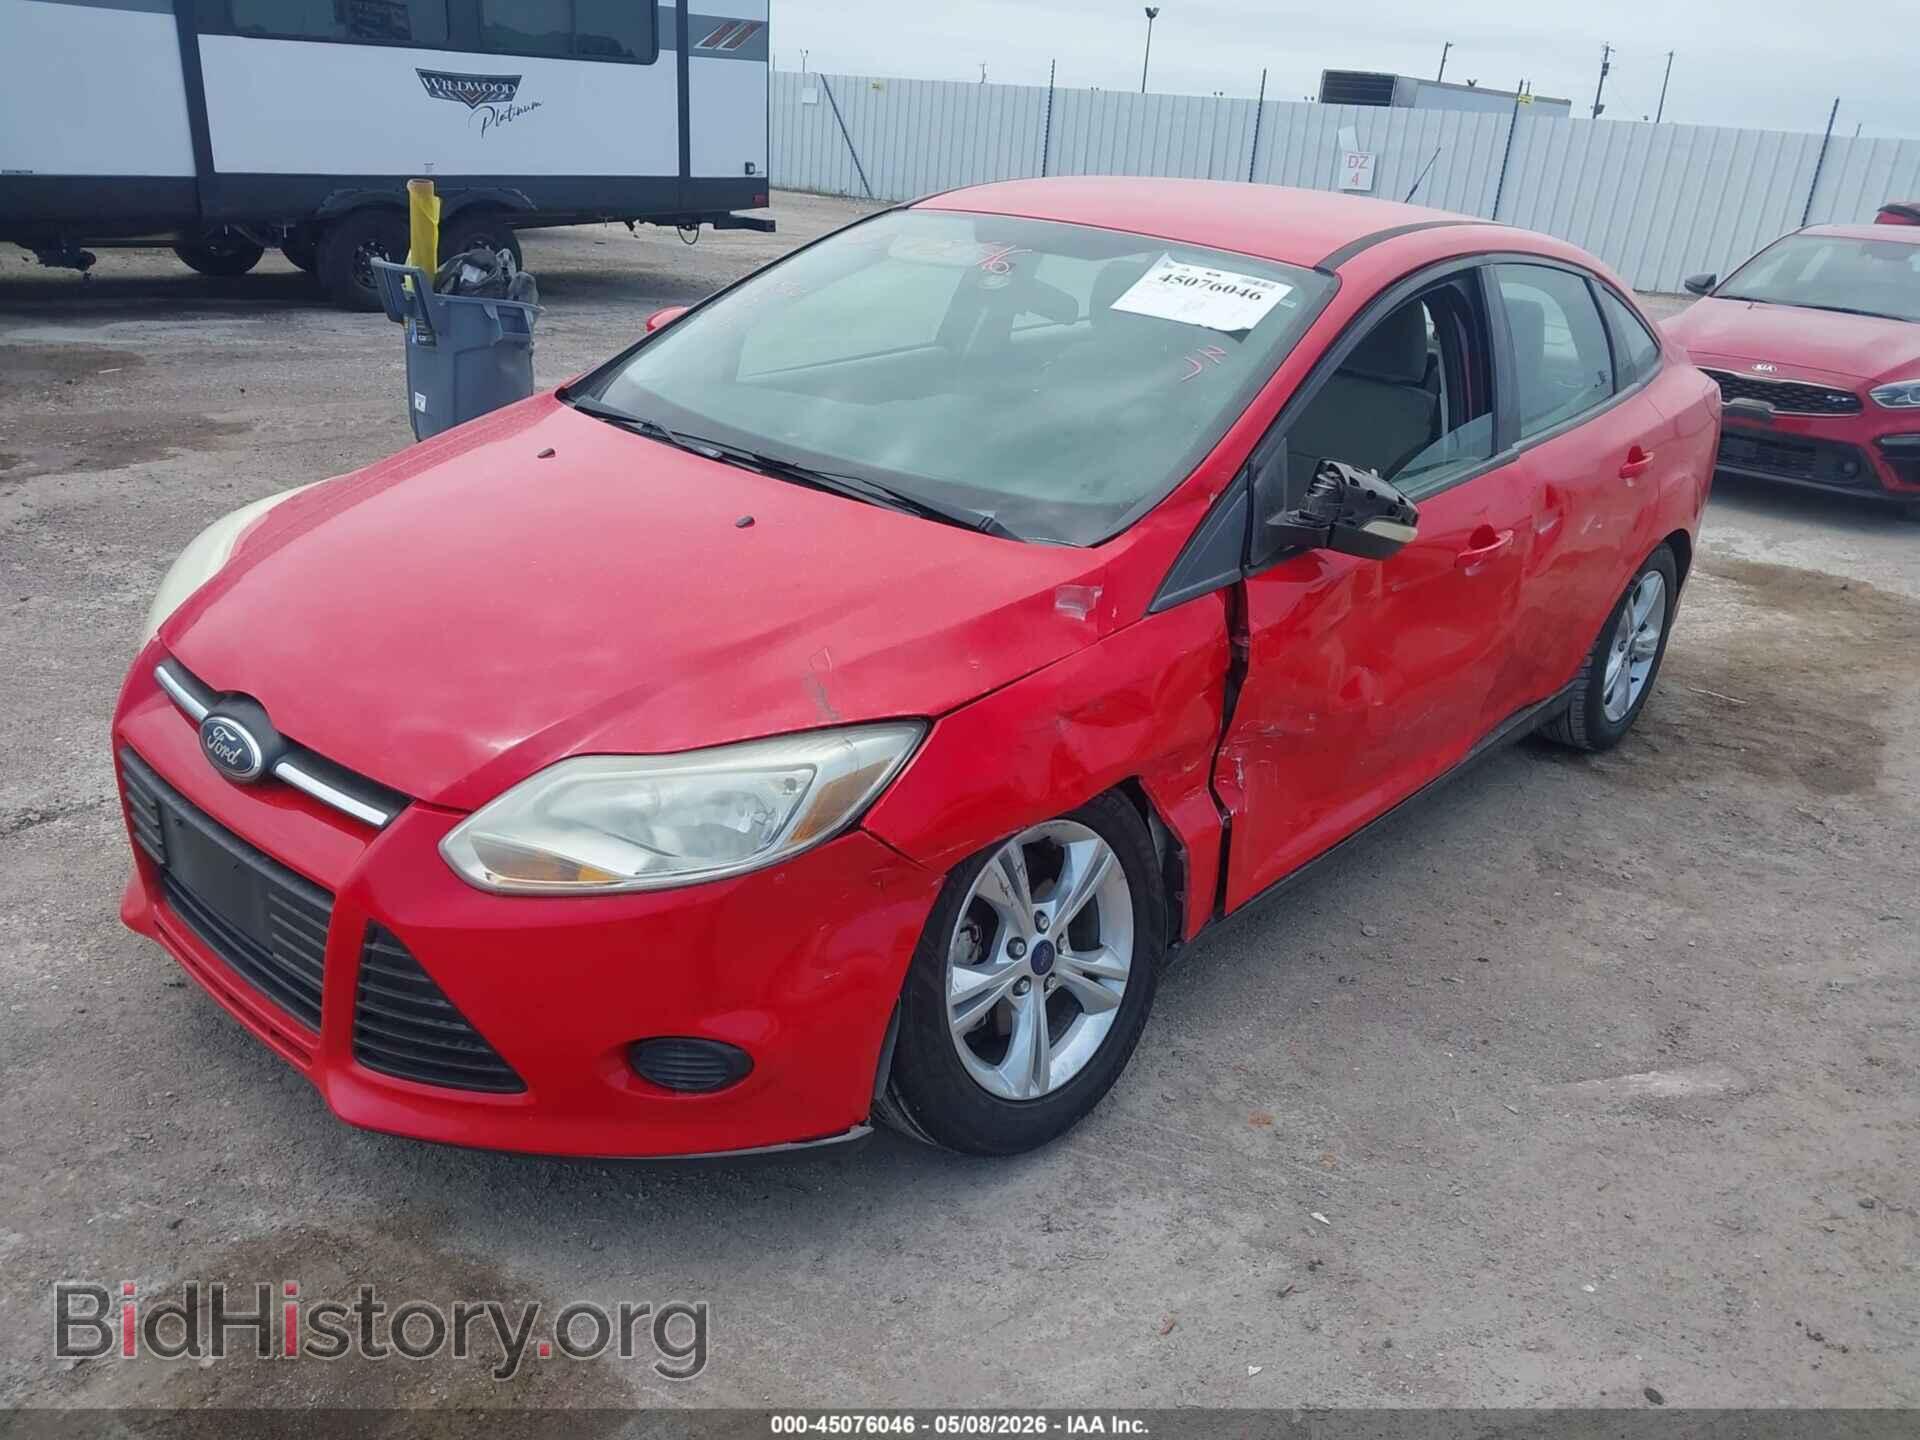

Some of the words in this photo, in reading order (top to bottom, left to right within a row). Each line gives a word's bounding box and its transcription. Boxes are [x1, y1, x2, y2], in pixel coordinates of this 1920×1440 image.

[422, 77, 517, 95] WILDWOOD
[467, 99, 543, 138] Platinum
[1347, 155, 1369, 168] DZ
[1351, 172, 1360, 185] 4
[1159, 273, 1263, 300] 45076046
[207, 726, 243, 765] Ford
